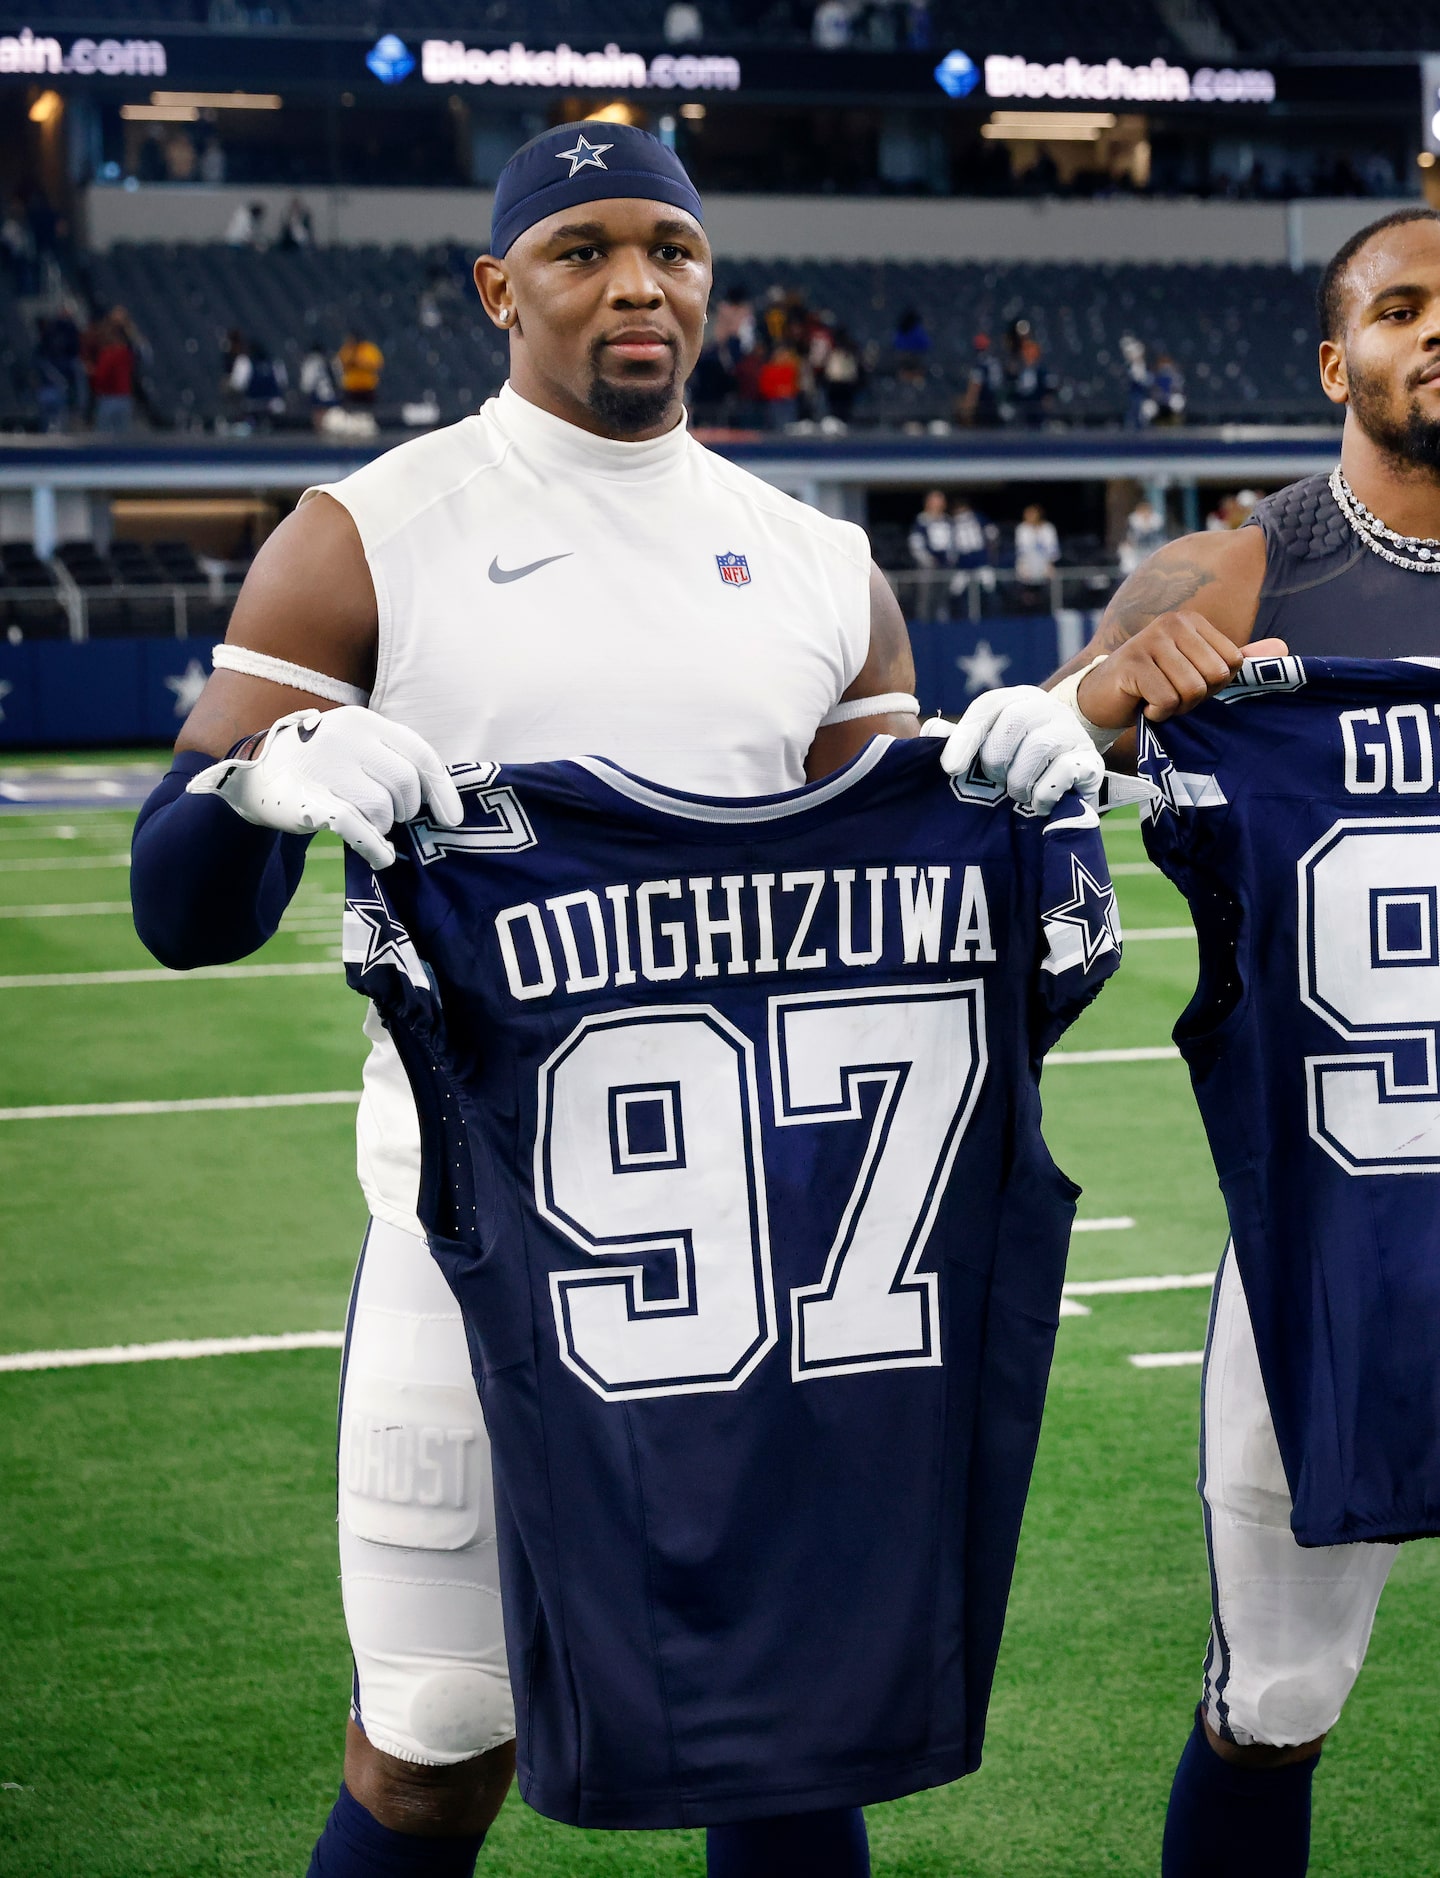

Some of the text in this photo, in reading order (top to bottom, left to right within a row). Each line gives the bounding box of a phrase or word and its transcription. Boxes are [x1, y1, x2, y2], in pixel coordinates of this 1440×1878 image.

[422, 40, 740, 90] Blockchain.com
[985, 55, 1276, 103] Blockchain.com
[721, 566, 749, 583] NFL
[494, 865, 997, 1001] ODIGHIZUWA
[533, 977, 988, 1402] 97
